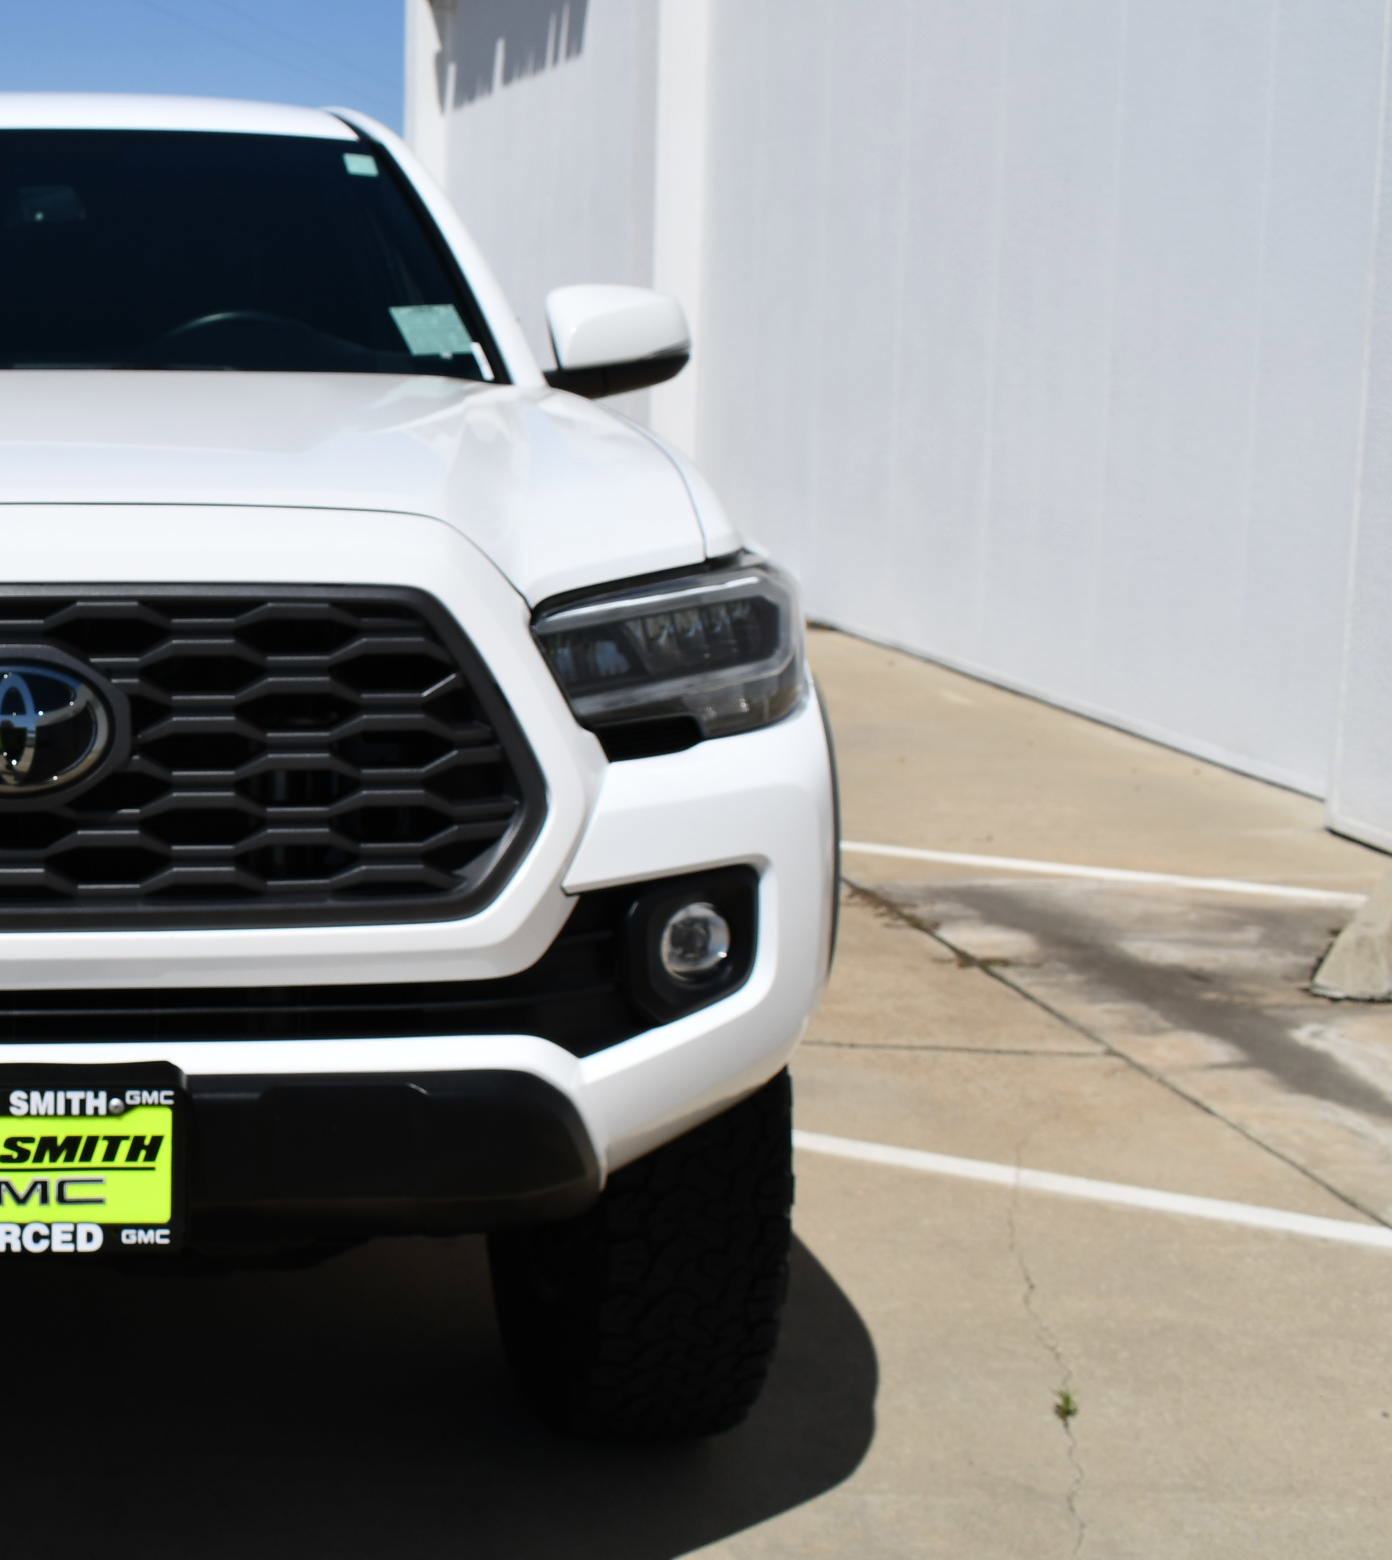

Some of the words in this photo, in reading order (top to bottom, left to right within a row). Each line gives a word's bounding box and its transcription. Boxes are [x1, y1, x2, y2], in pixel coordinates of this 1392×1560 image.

[10, 1090, 107, 1116] SMITH
[125, 1090, 175, 1105] GMC
[121, 1229, 170, 1244] GMC
